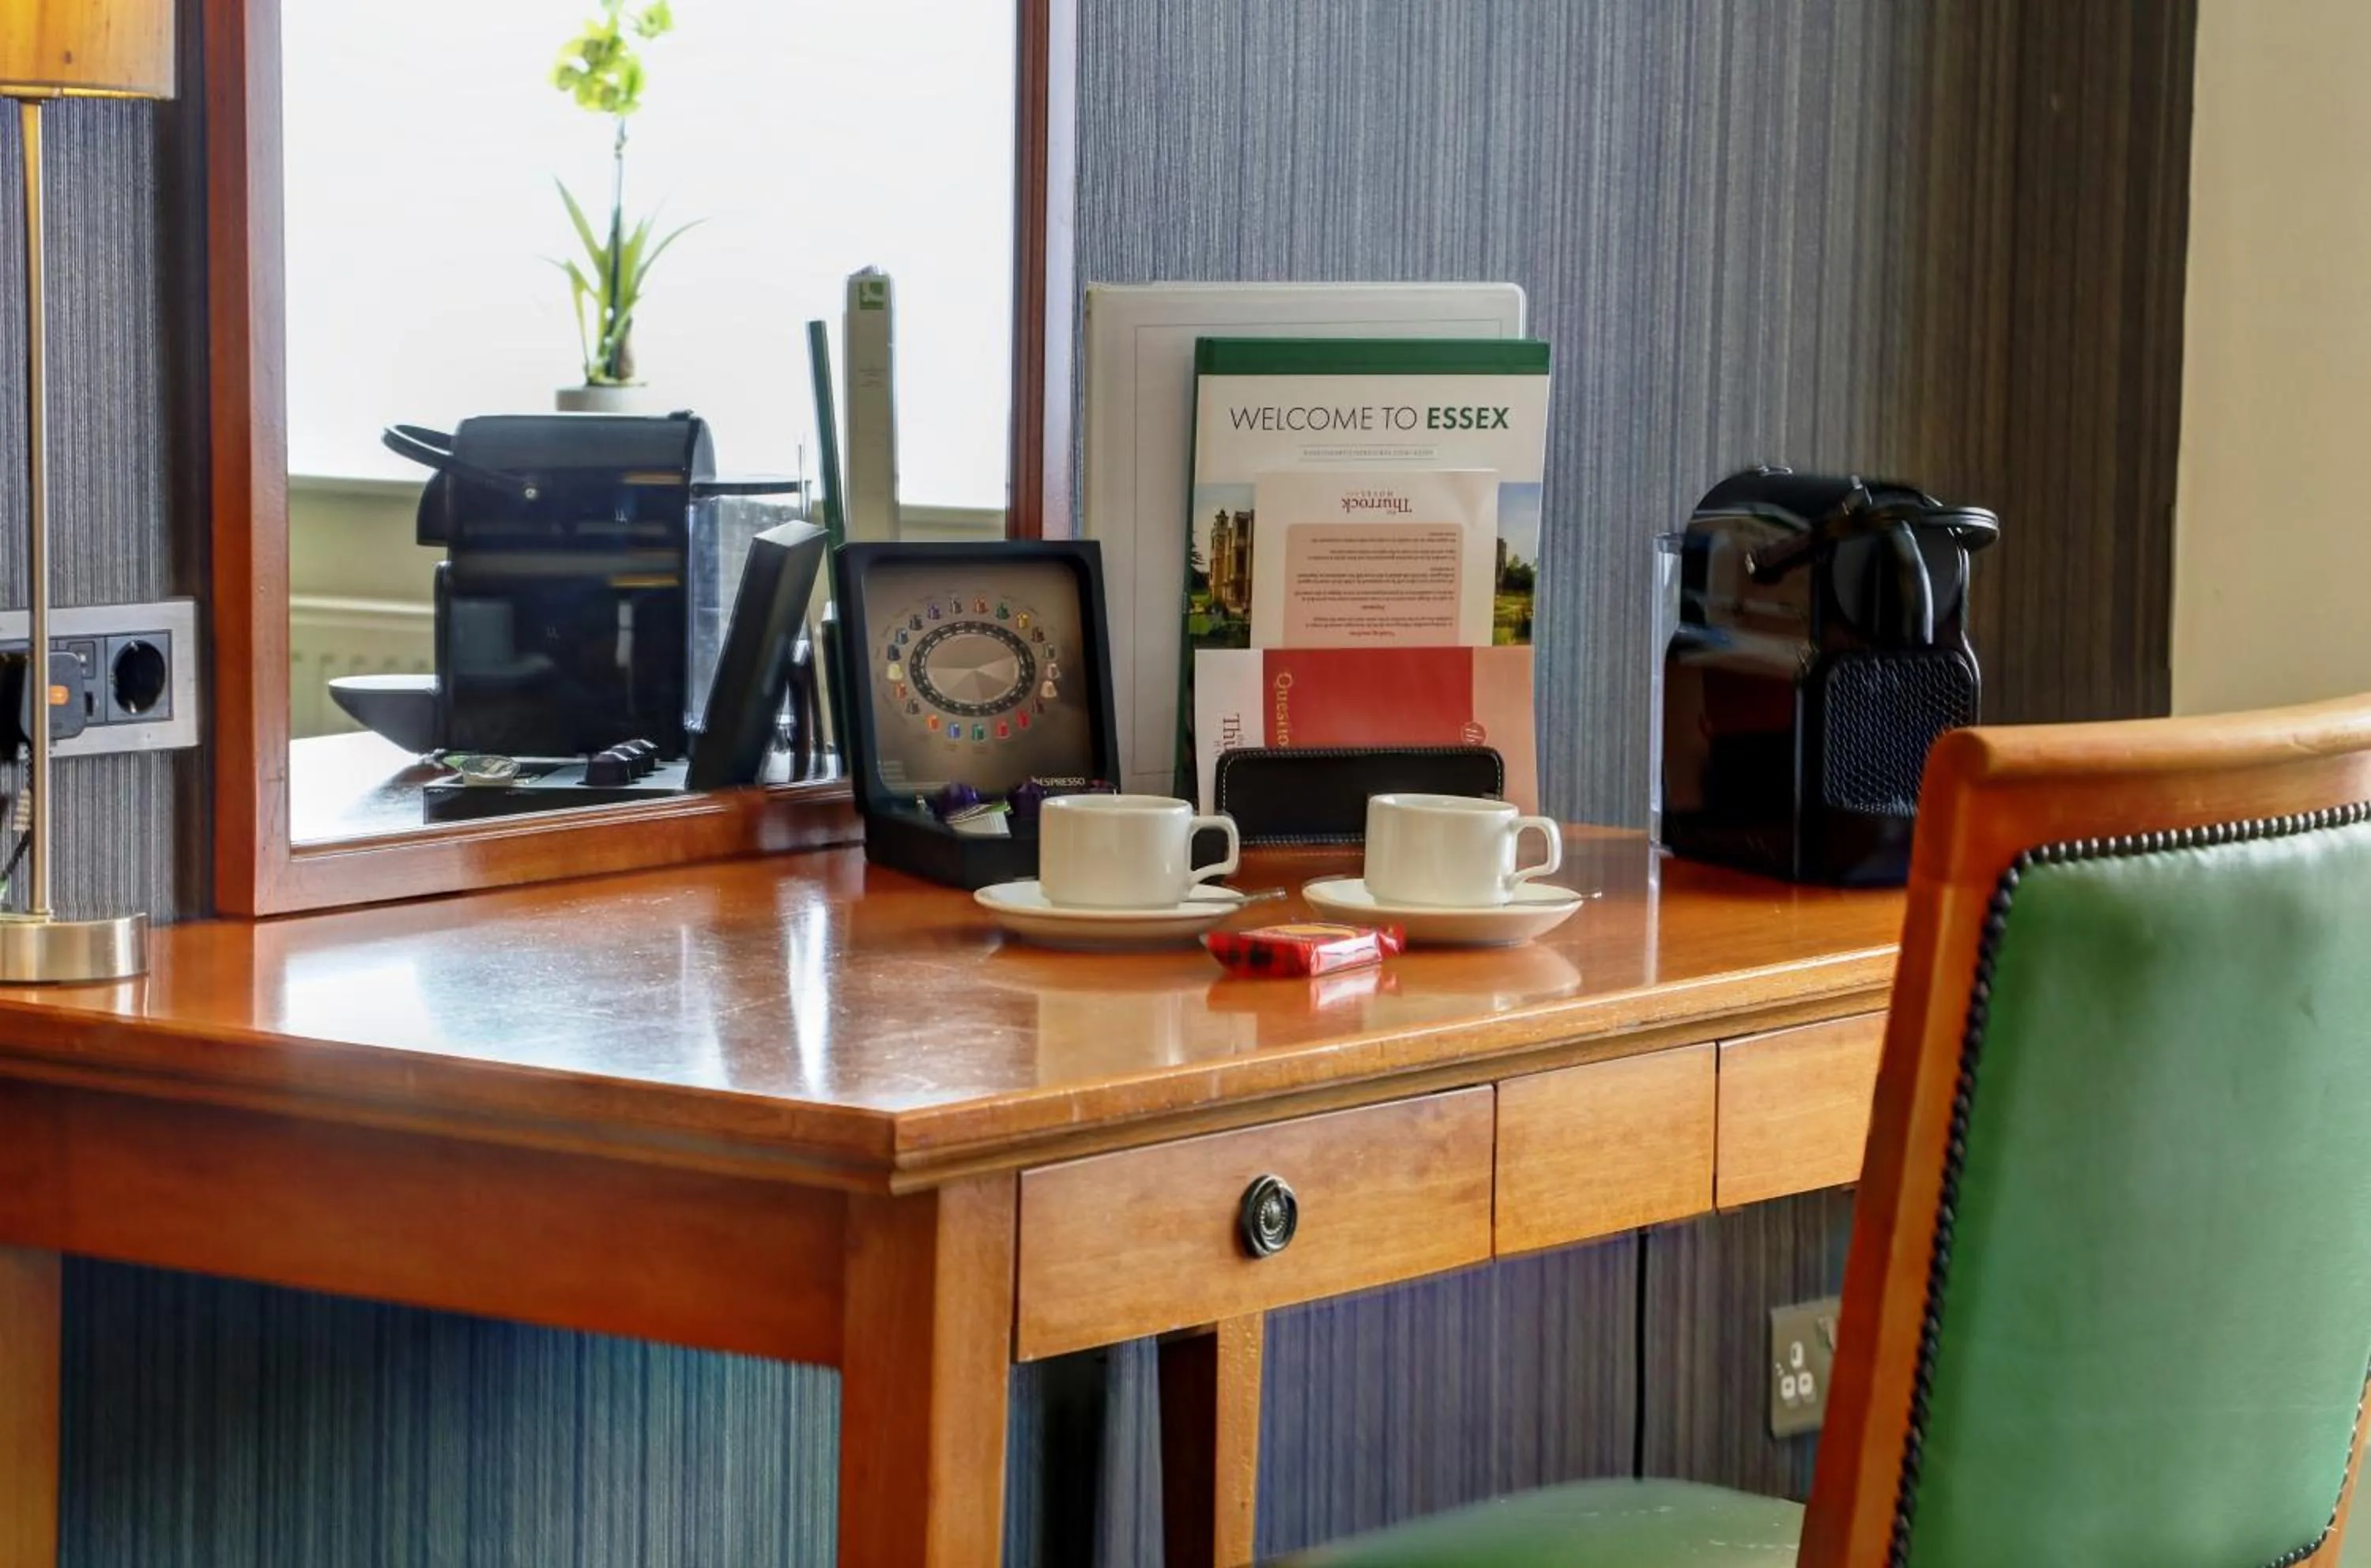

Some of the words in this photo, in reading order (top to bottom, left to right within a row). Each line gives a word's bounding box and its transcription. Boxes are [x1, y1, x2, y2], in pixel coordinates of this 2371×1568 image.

[1230, 406, 1374, 431] WELCOME
[1382, 406, 1418, 431] TO
[1426, 406, 1511, 430] ESSEX
[1341, 498, 1412, 514] Thurrock
